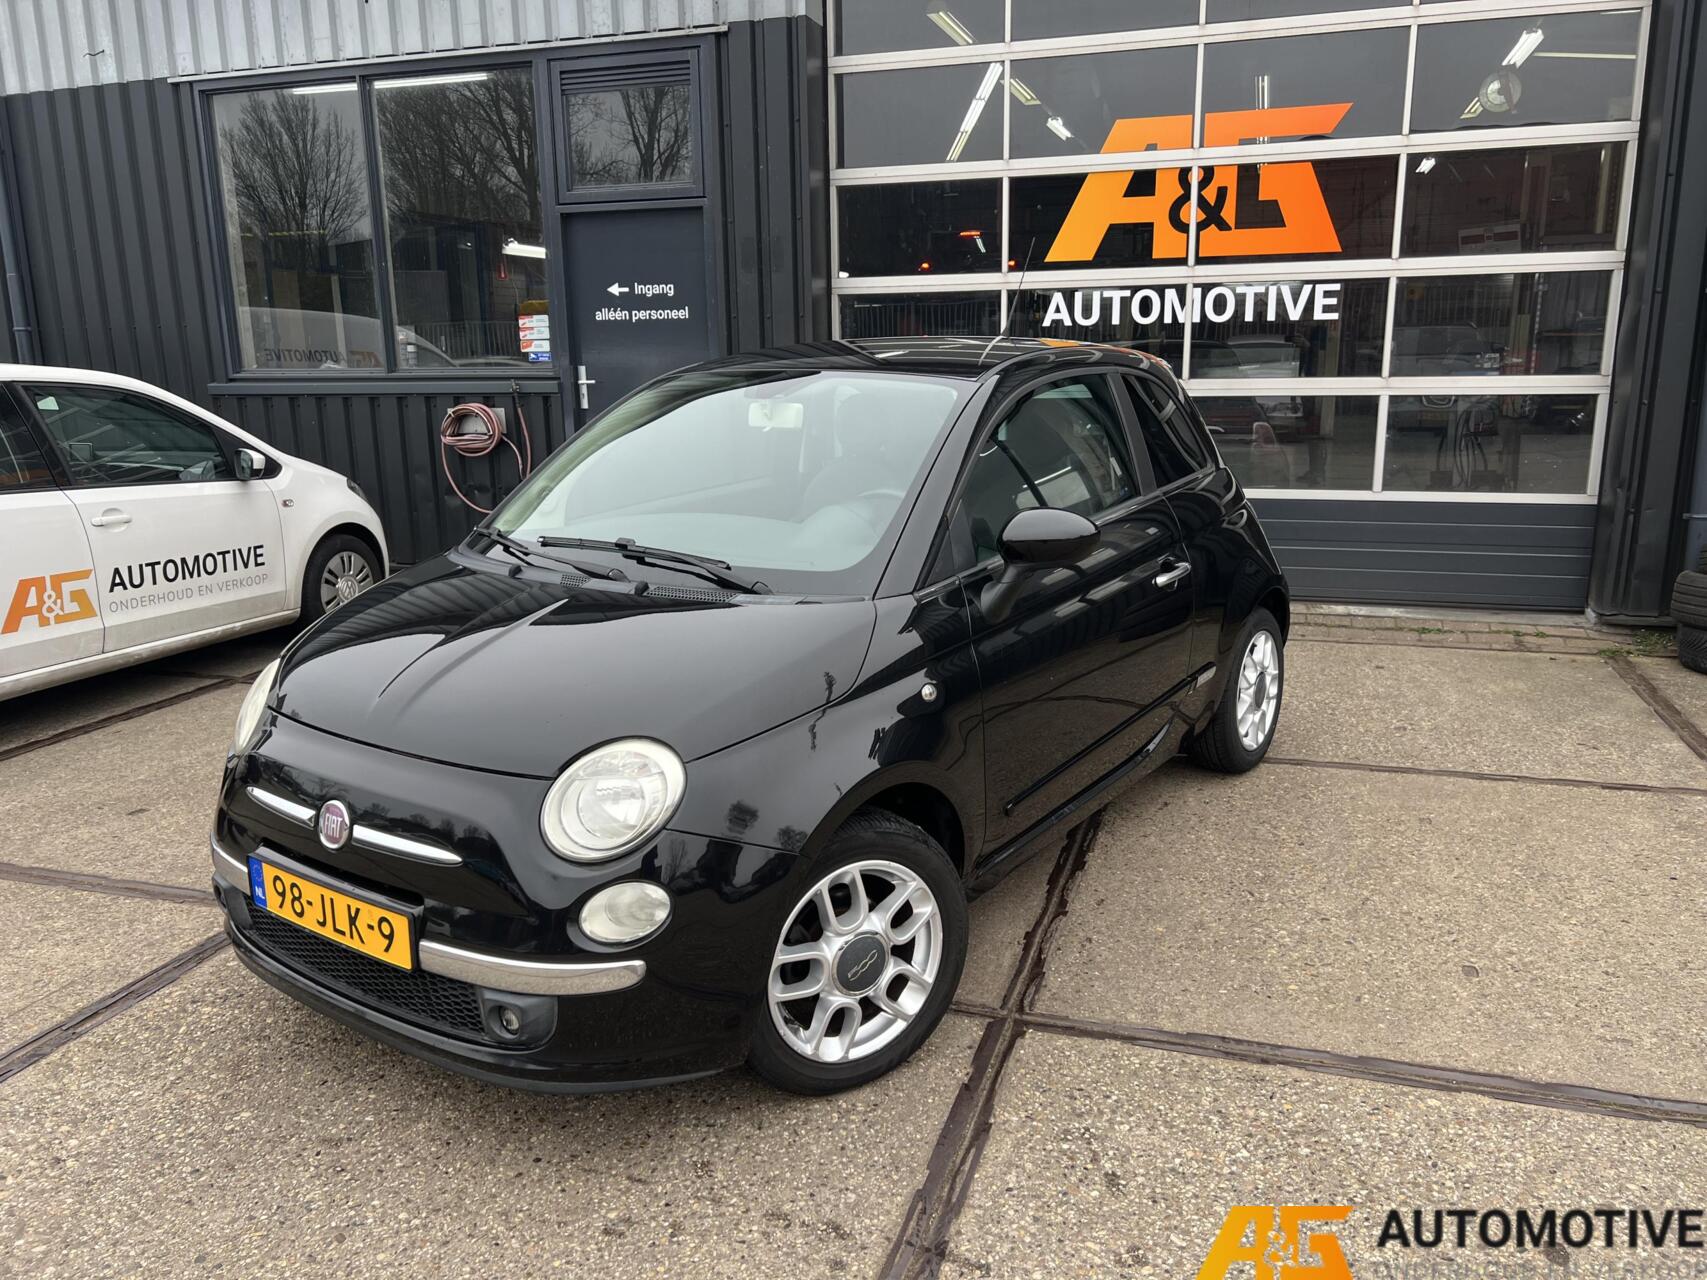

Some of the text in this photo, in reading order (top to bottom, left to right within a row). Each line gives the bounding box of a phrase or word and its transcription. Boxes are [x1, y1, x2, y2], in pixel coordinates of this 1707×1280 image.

[1044, 102, 1354, 263] A&G
[634, 282, 674, 297] Ingang
[1042, 283, 1341, 327] AUTOMOTIVE
[595, 306, 689, 322] alléén personeel
[109, 544, 266, 593] AUTOMOTIVE
[1, 568, 98, 634] A&G
[109, 573, 269, 613] ONDERHOUD EN VERKOOP
[324, 813, 344, 839] FIAT
[254, 885, 266, 899] NL
[272, 874, 395, 953] 98-JLK-9
